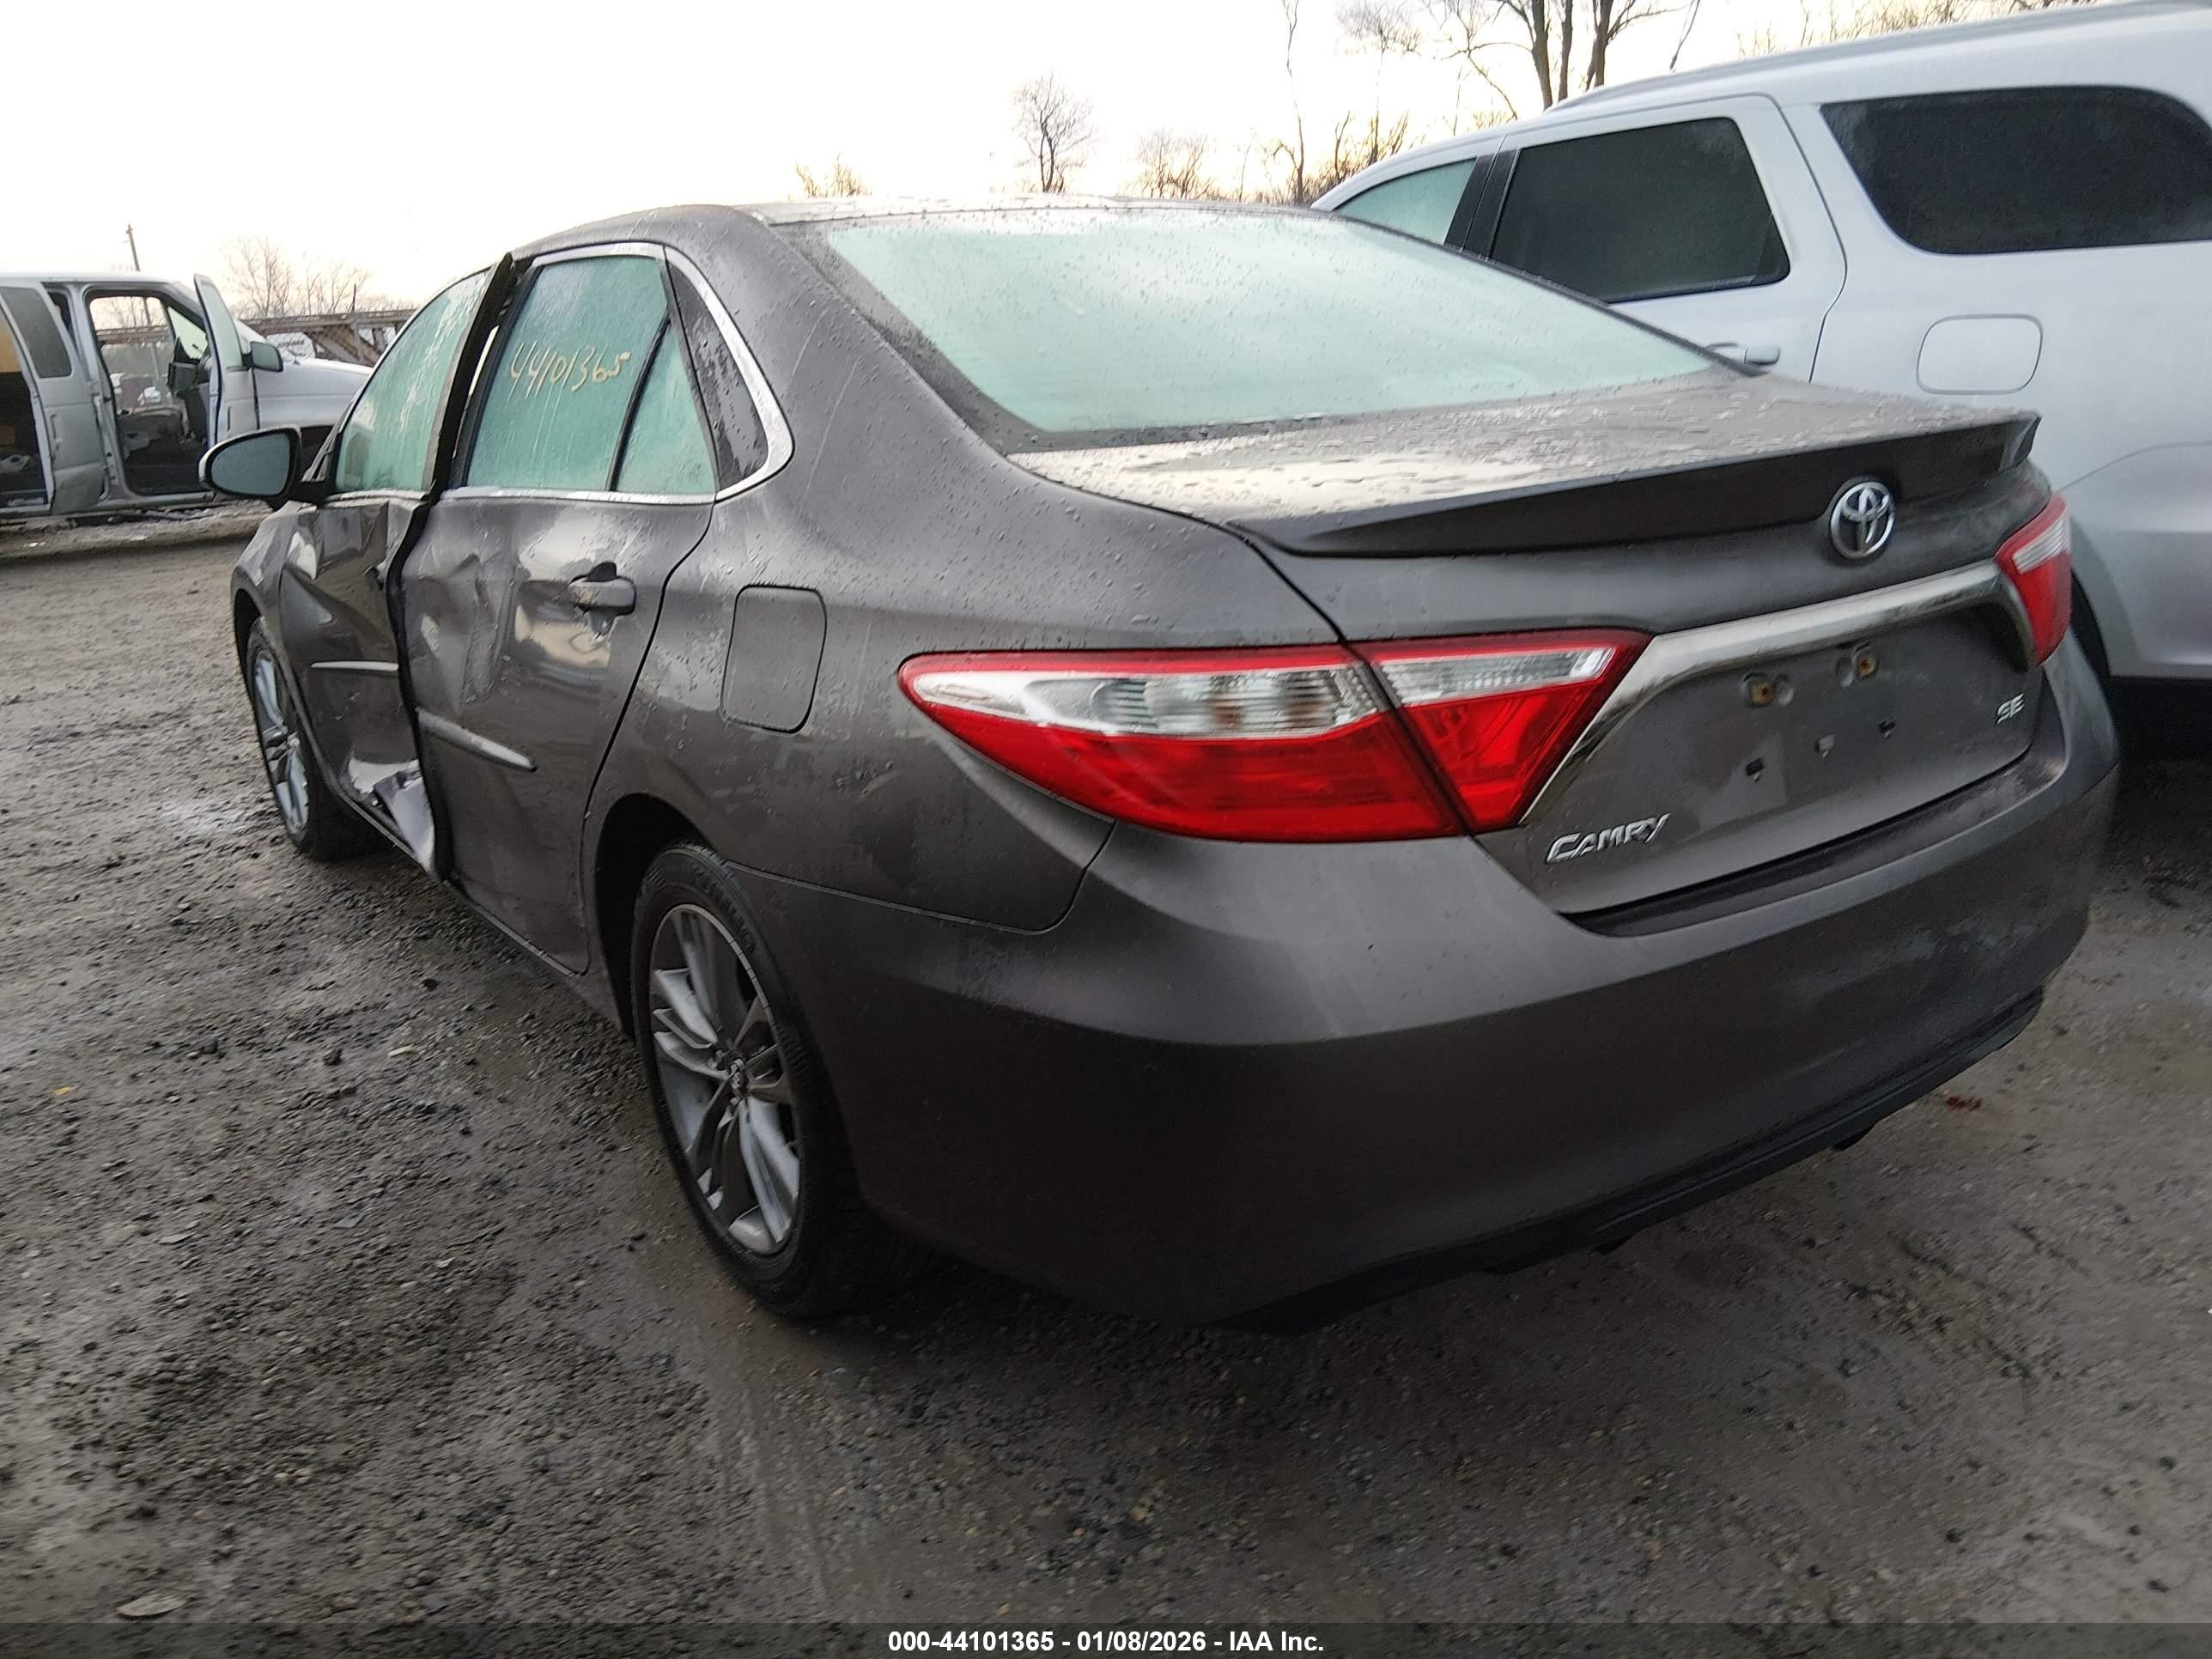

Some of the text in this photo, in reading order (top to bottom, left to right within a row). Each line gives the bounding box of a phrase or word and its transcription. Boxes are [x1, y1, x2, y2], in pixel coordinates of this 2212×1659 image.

[509, 340, 632, 400] 44101365
[1997, 693, 2025, 725] SE
[1546, 813, 1670, 863] CAMRY
